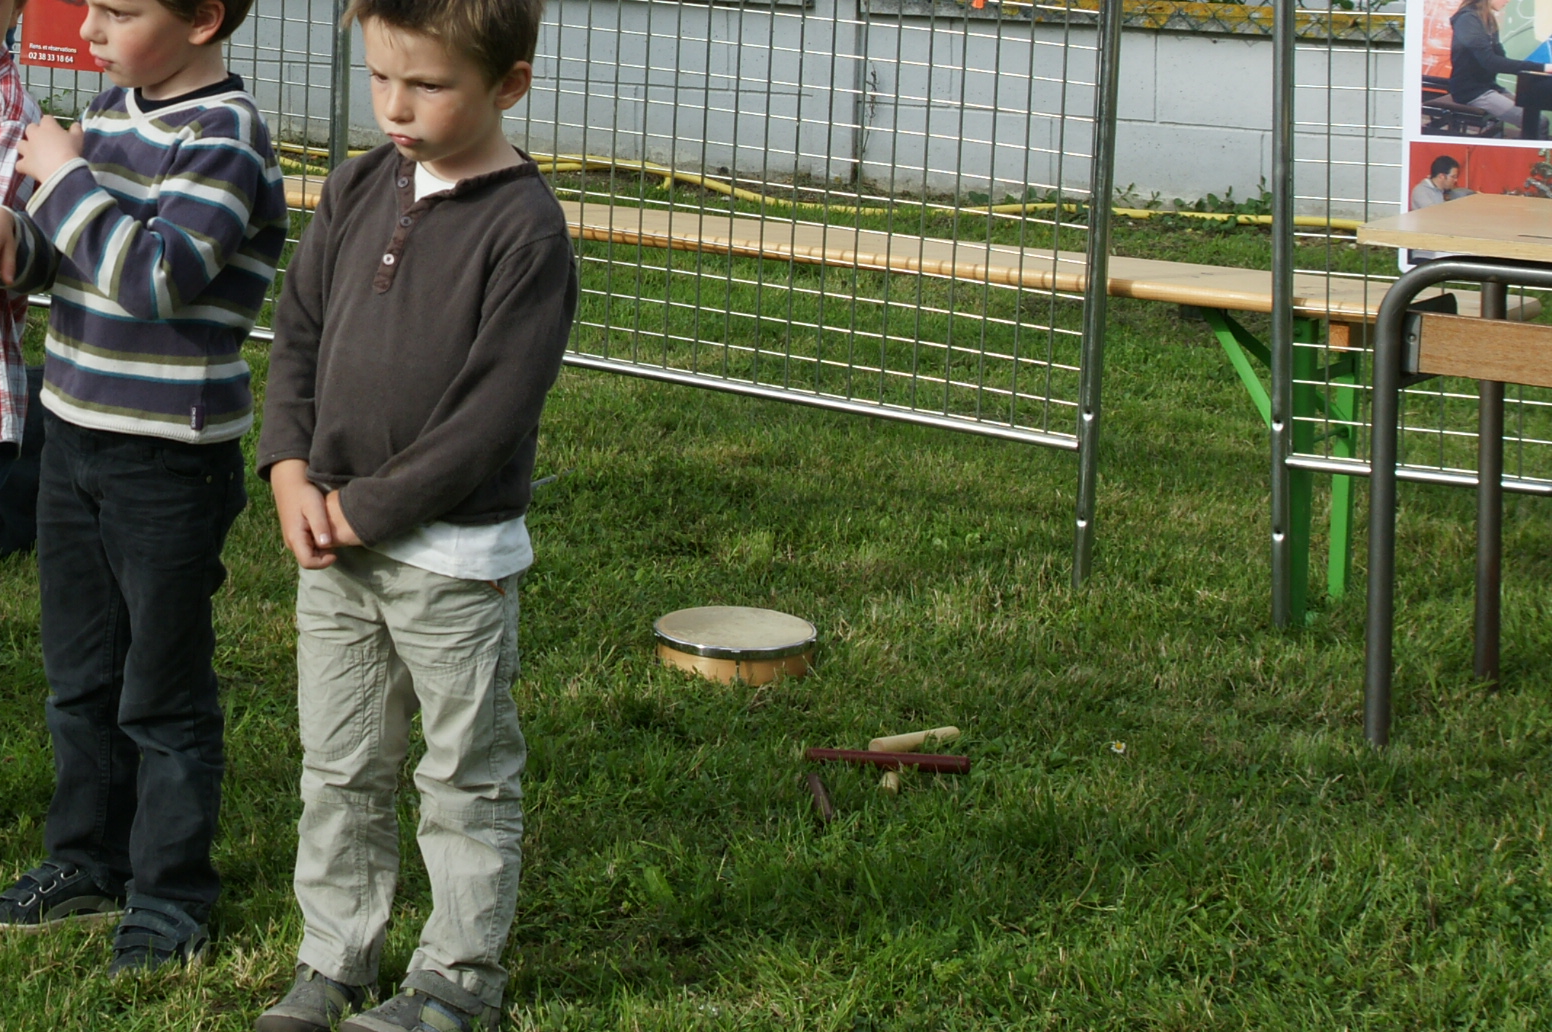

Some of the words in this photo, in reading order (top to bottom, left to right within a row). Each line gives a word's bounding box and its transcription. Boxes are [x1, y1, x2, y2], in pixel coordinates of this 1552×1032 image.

[47, 44, 77, 54] réservations
[28, 51, 38, 60] 02
[38, 52, 47, 61] 38
[47, 54, 55, 62] 33
[56, 54, 65, 63] 18
[65, 55, 74, 64] 64
